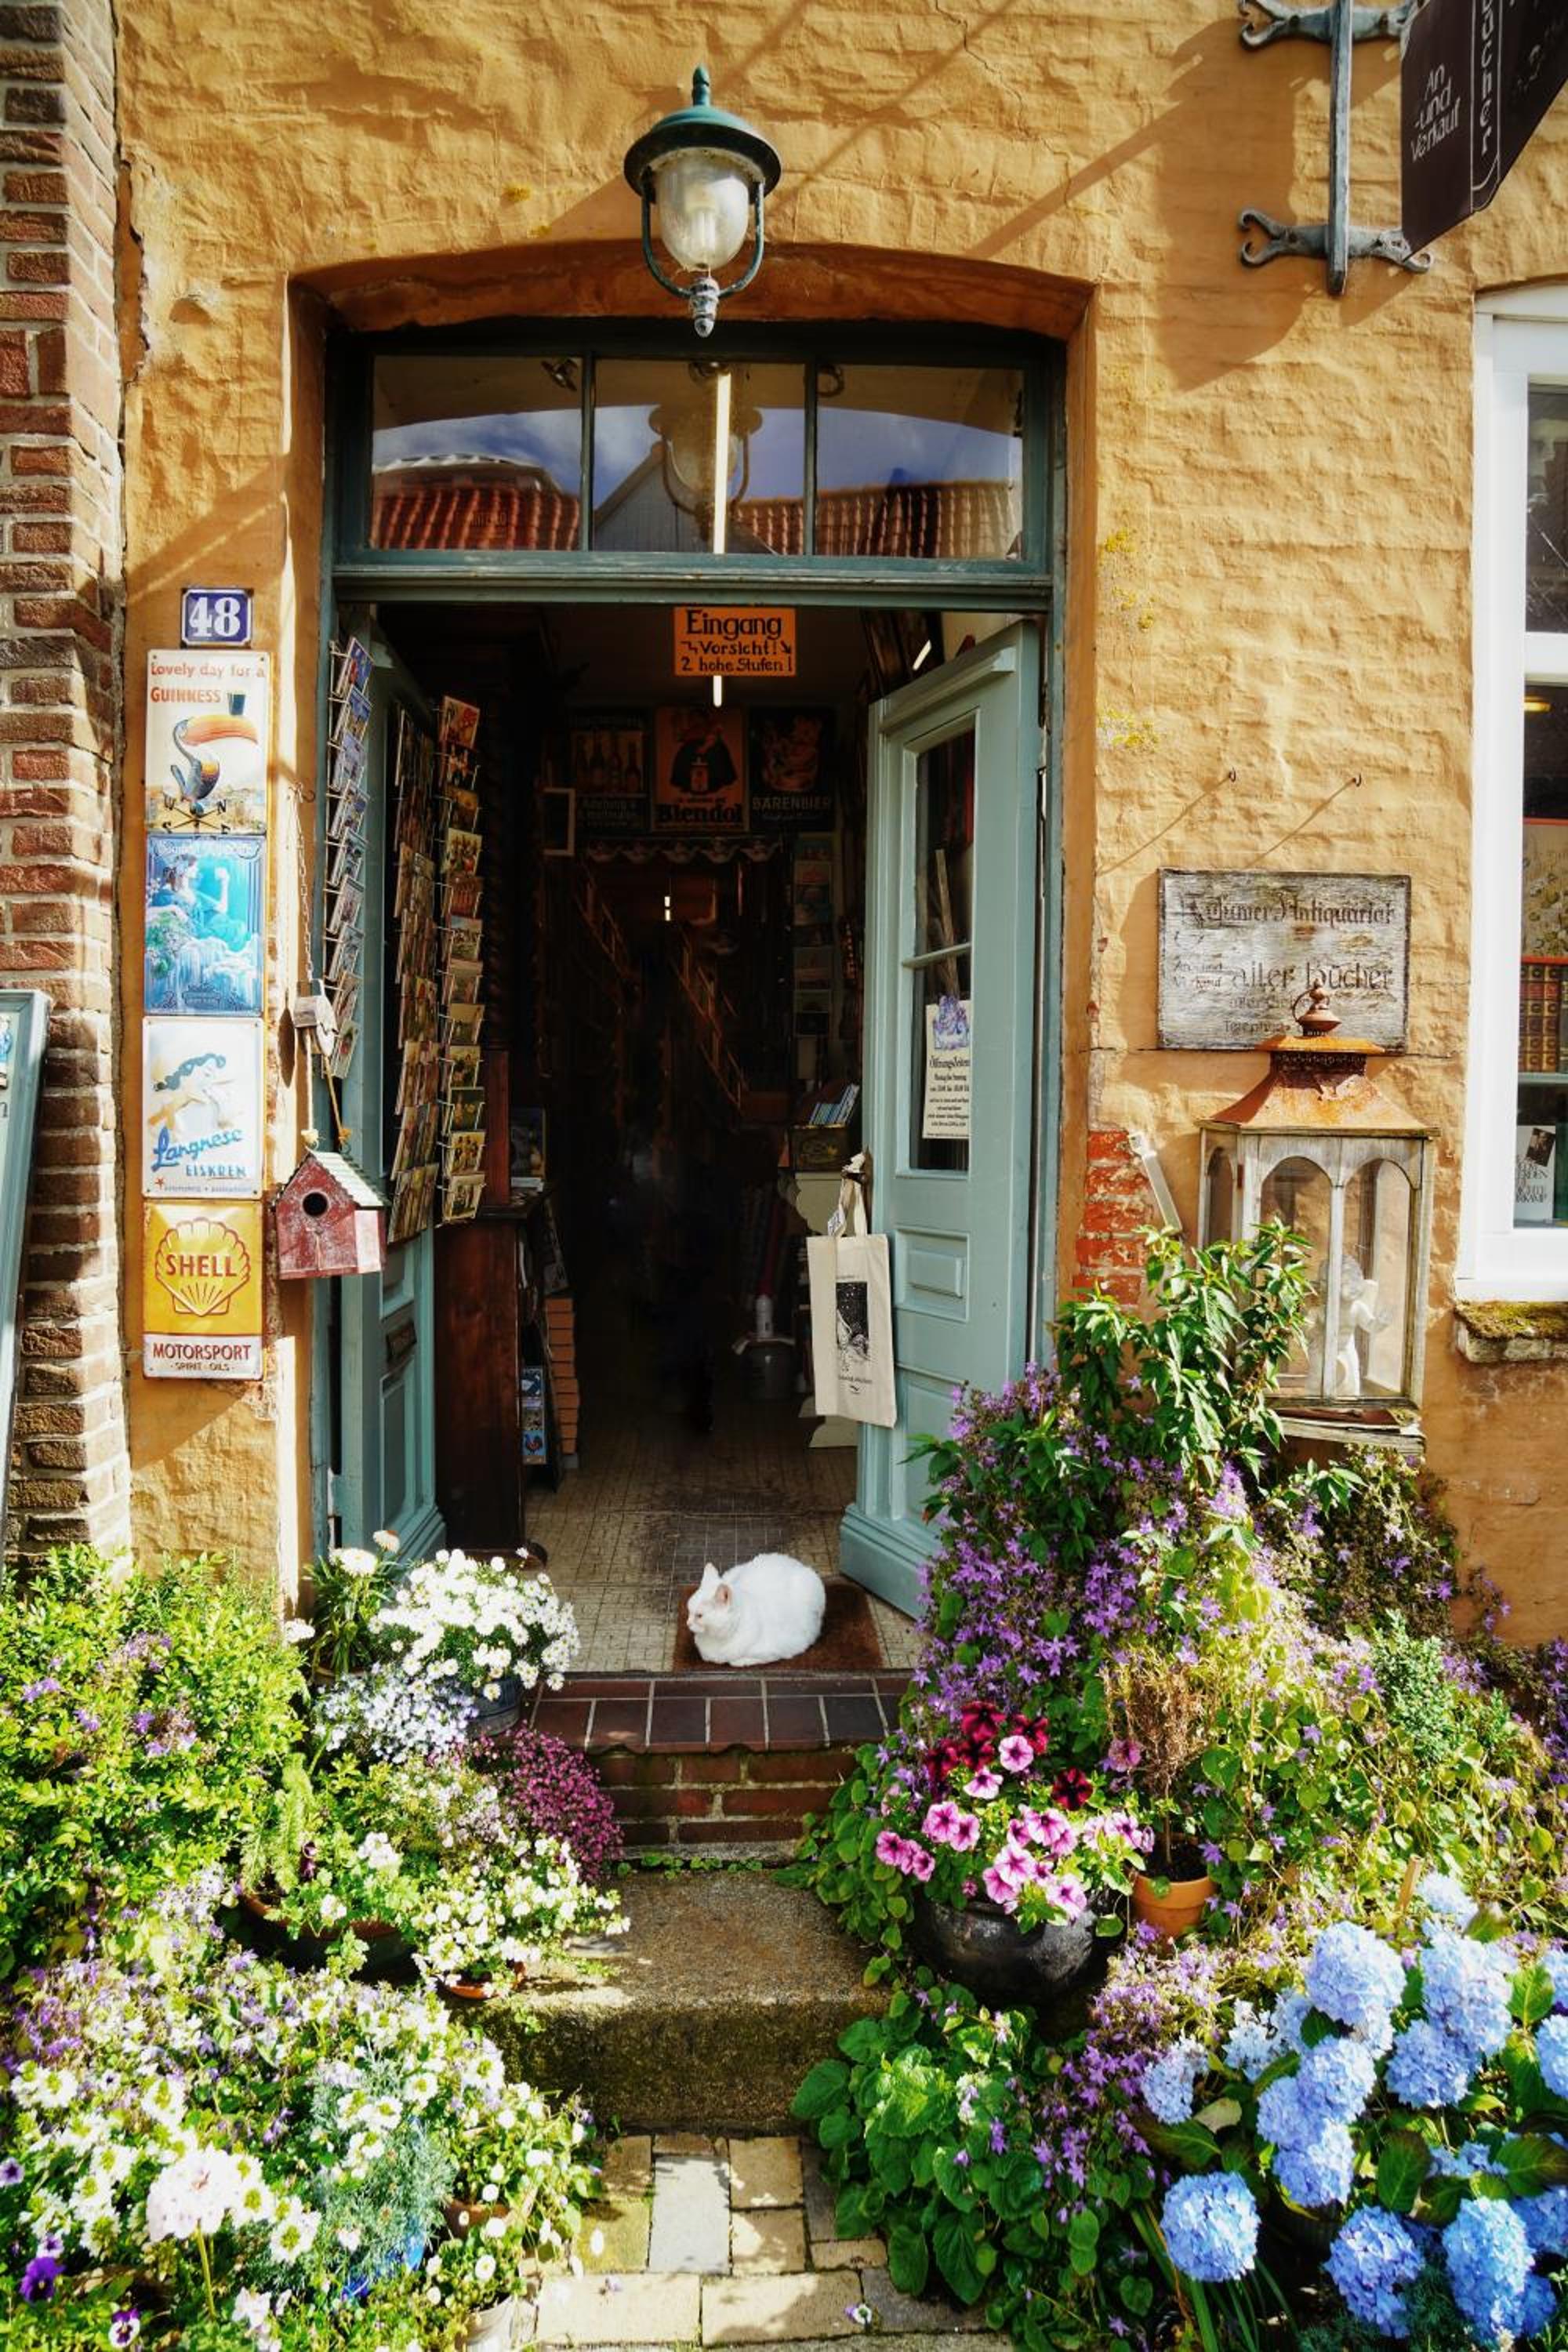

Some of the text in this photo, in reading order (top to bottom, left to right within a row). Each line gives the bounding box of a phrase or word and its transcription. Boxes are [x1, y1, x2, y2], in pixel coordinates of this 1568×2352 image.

[189, 597, 241, 637] 48
[686, 610, 782, 640] Eingang
[151, 662, 265, 679] Lovely day for a
[681, 656, 691, 671] 2
[699, 657, 734, 671] hohe
[151, 687, 220, 702] GUINNESS
[151, 1126, 243, 1172] Langnese
[166, 1255, 238, 1277] SHELL
[154, 1344, 251, 1360] MOTORSPORT
